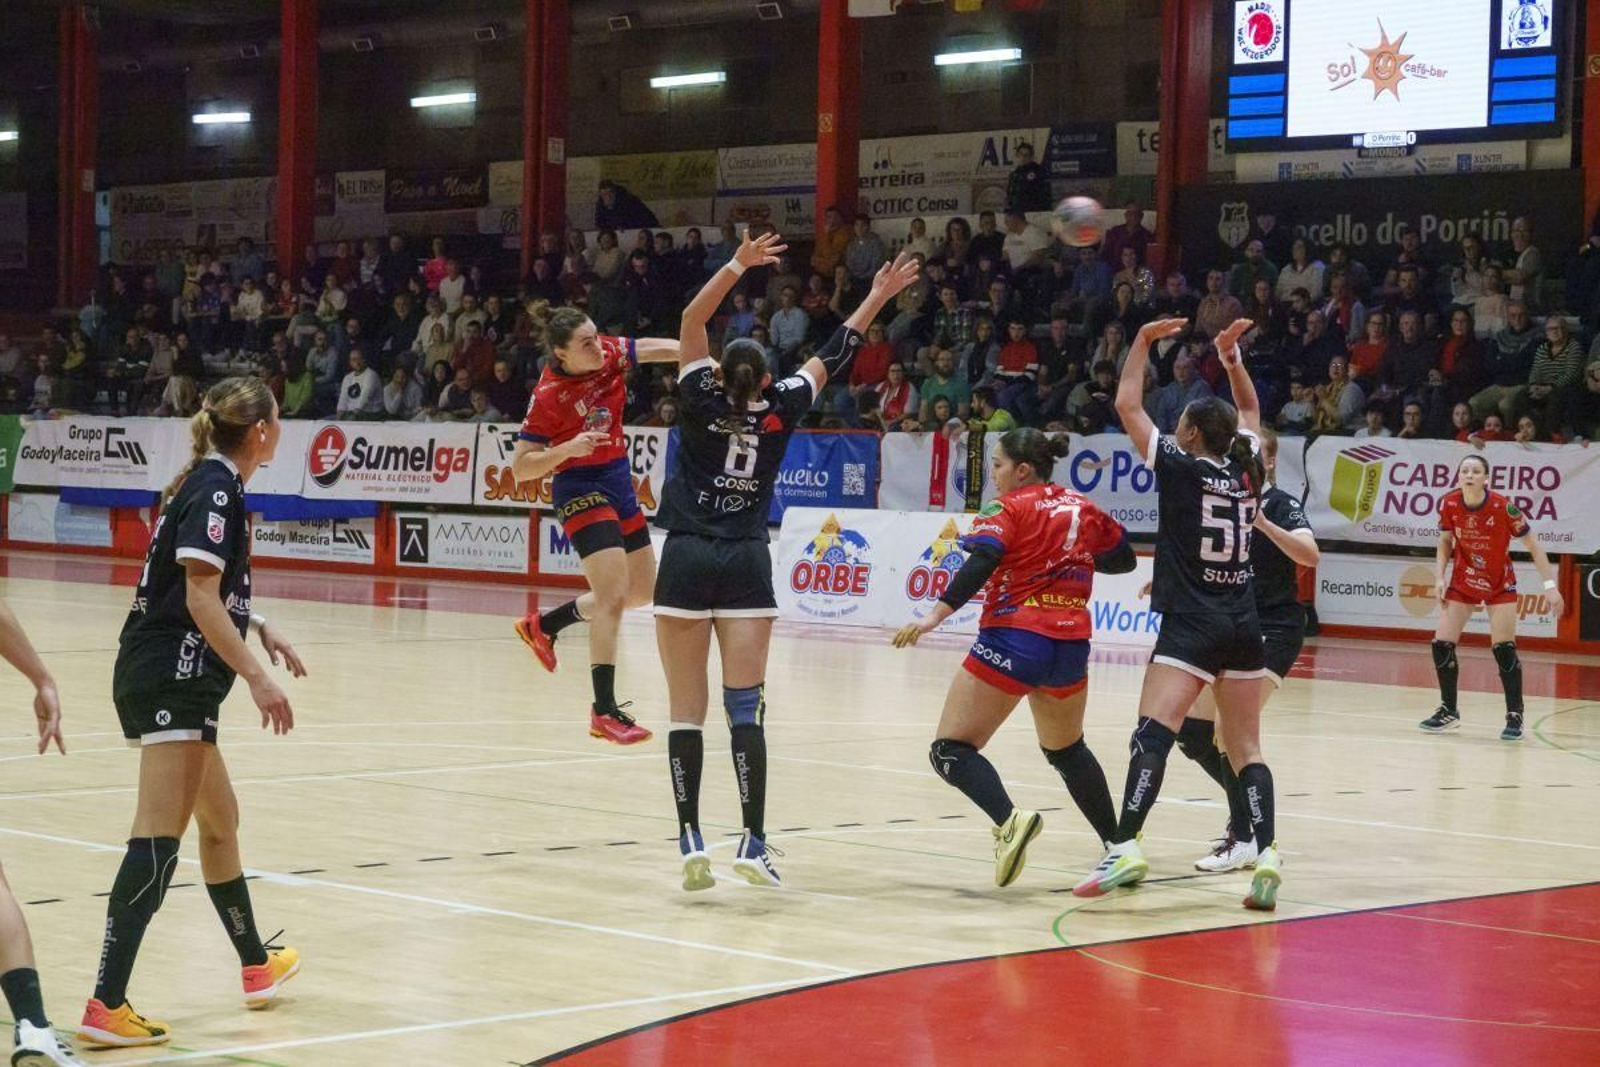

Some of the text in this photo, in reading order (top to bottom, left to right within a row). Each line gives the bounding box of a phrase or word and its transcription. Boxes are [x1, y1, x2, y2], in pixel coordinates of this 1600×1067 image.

[1326, 55, 1357, 82] Sol
[858, 170, 925, 188] erreira
[873, 197, 913, 214] CITIC
[1296, 213, 1370, 246] ncello
[1420, 210, 1510, 243] Porriñ
[69, 424, 102, 444] Grupo
[21, 445, 58, 464] Godoy
[348, 436, 470, 484] Sumelga
[724, 433, 759, 479] 6
[345, 473, 382, 481] MATERIAL
[713, 475, 760, 492] COSIC
[1070, 448, 1102, 492] O
[1388, 462, 1561, 491] CABAEIRO
[565, 493, 607, 517] CASTR
[255, 528, 330, 546] Godoy Maceira
[1049, 505, 1082, 552] 7
[1363, 522, 1406, 535] Canteras
[1409, 527, 1416, 538] y
[1537, 531, 1573, 543] natural
[791, 560, 870, 596] ORBE
[1321, 580, 1394, 597] Recambios
[1094, 600, 1162, 634] Work
[671, 757, 688, 802] Kempa
[735, 752, 751, 803] Kempa
[1126, 768, 1152, 812] Kempa
[1252, 785, 1264, 824] Kempa
[228, 906, 247, 937] Kempa
